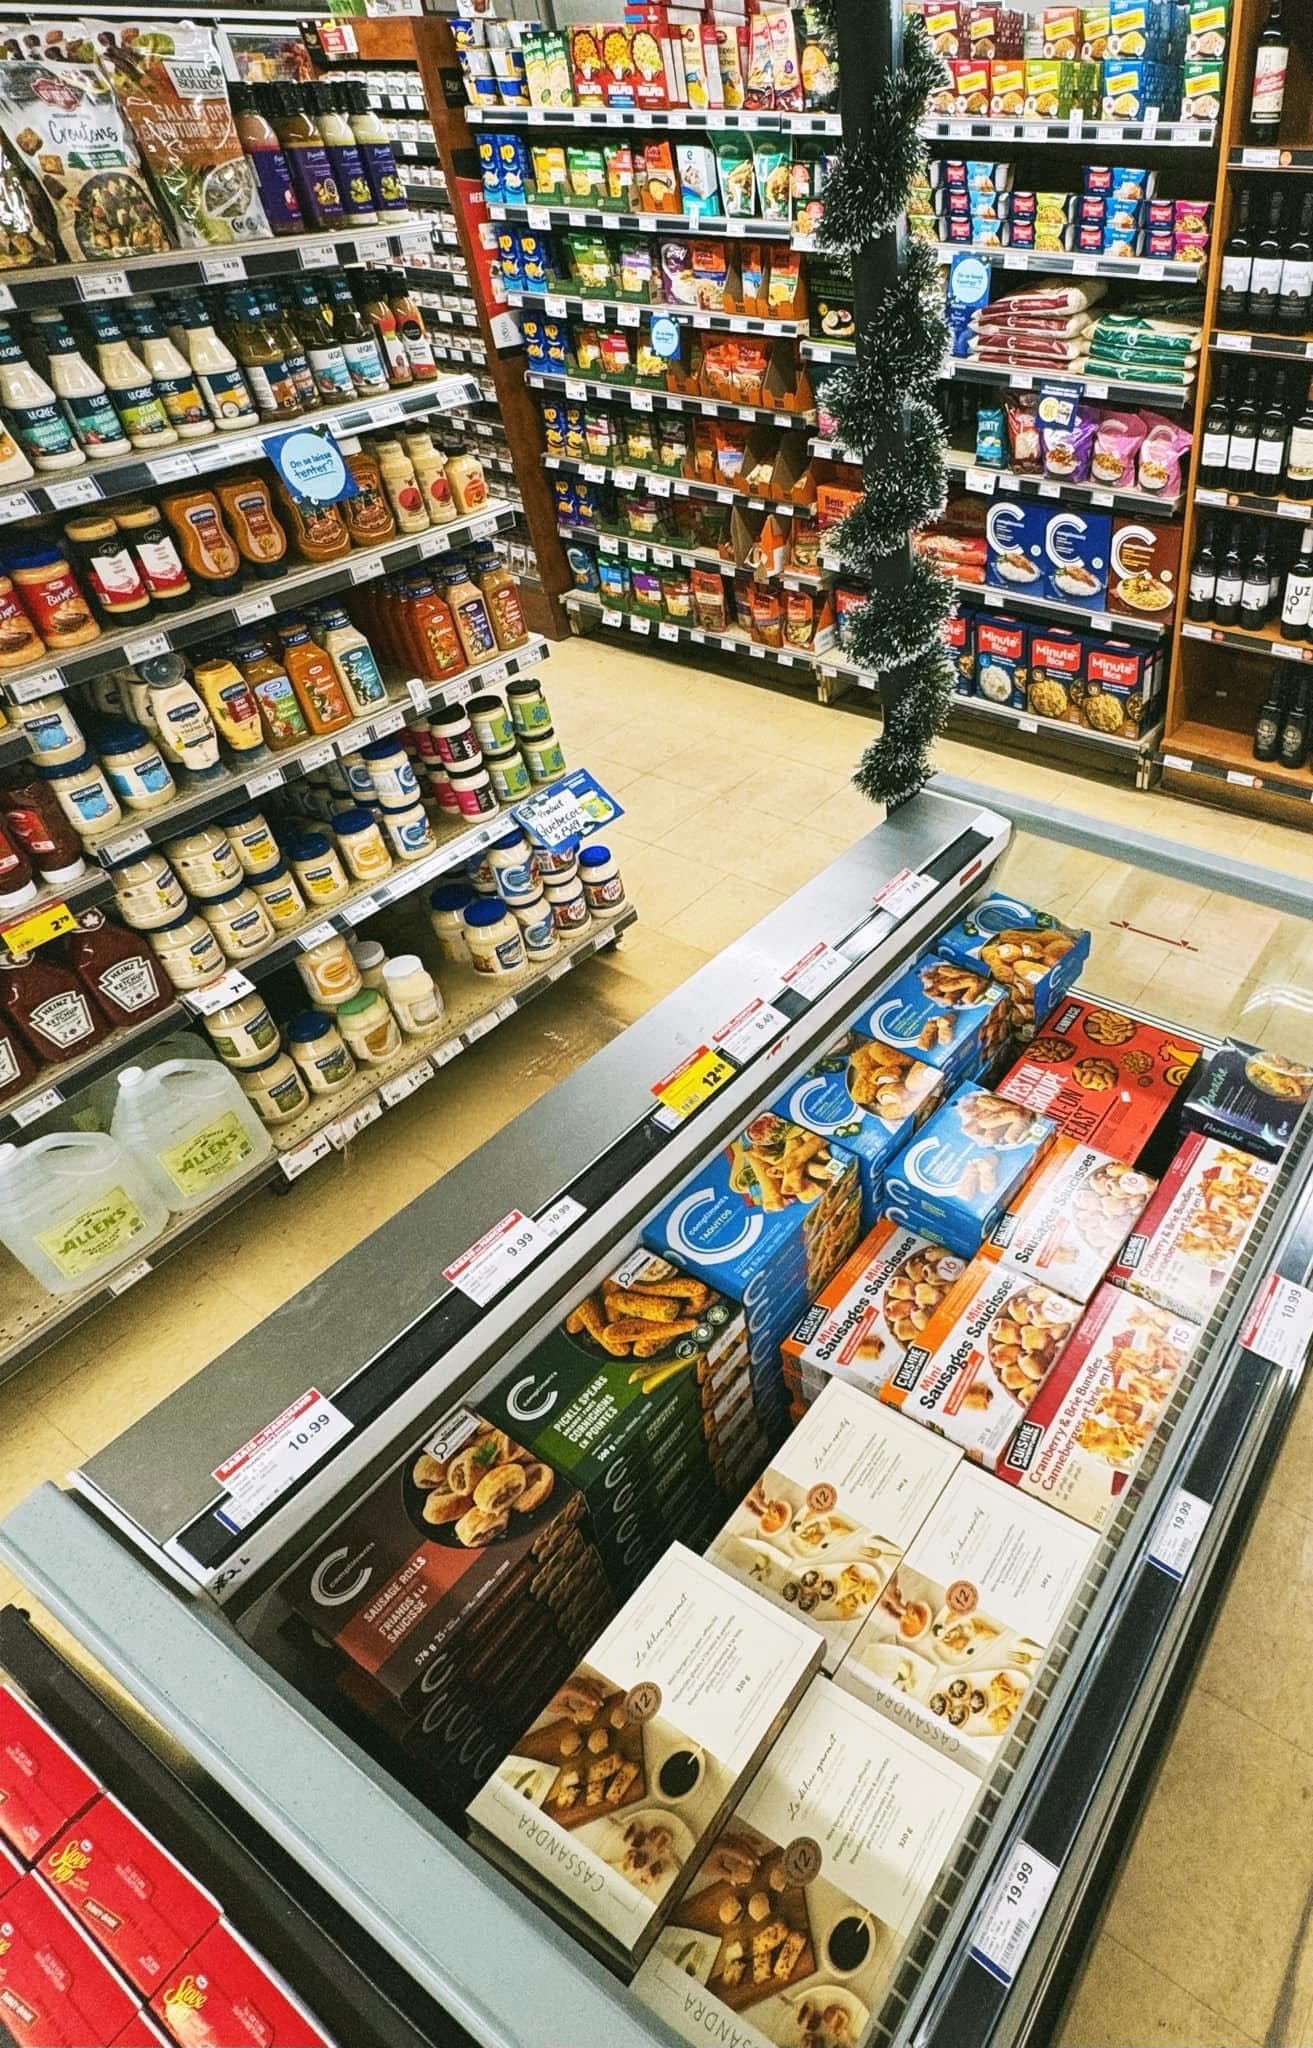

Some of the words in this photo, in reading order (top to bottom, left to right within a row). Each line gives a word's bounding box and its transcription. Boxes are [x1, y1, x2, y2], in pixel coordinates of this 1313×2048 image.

[48, 119, 118, 145] Croutons
[289, 458, 303, 470] On
[311, 452, 333, 465] laisse
[980, 631, 1018, 648] Minute
[1035, 644, 1078, 662] Minute
[1091, 657, 1135, 675] Minute
[109, 962, 135, 980] HEINZ
[113, 971, 146, 992] KETCHUP
[42, 997, 69, 1016] HEINZ
[45, 1005, 79, 1028] KETCHUP
[180, 1131, 238, 1173] ALLEN'S
[1057, 1152, 1097, 1206] Saucisses
[548, 1203, 571, 1225] 10.99
[689, 1194, 729, 1236] compliments
[699, 1208, 733, 1242] TAQUITOS
[61, 1207, 128, 1254] ALLEN'S
[506, 1232, 534, 1257] 9.99
[865, 1259, 885, 1281] Mini
[939, 1261, 957, 1274] 16
[815, 1296, 870, 1361] Sausages
[864, 1235, 917, 1295] Saucisses
[965, 1300, 986, 1323] Mini
[1282, 1289, 1302, 1319] 10.99
[817, 1320, 840, 1345] Mini
[919, 1338, 974, 1409] Sausages
[965, 1273, 1018, 1338] Saucisses
[1172, 1328, 1189, 1344] 15
[895, 1346, 924, 1387] CUISINE
[919, 1365, 942, 1392] Mini
[553, 1402, 582, 1433] PICKLE
[578, 1375, 609, 1406] SPEARS
[568, 1394, 615, 1443] CORNICHONS
[288, 1413, 331, 1452] 10.99
[585, 1406, 619, 1440] POINTES
[1029, 1427, 1067, 1484] Cranberry
[1064, 1394, 1080, 1418] Brie
[1077, 1357, 1104, 1397] Bundles
[1009, 1424, 1035, 1466] CUISINE
[1041, 1419, 1086, 1491] Canneberges
[815, 1490, 829, 1507] 12
[1173, 1501, 1192, 1530] 19.99
[363, 1581, 402, 1623] SAUSAGE
[399, 1555, 428, 1586] ROLLS
[955, 1588, 971, 1608] 12
[378, 1593, 415, 1638] FRIANDS
[385, 1599, 429, 1645] SAUCISSE
[634, 1693, 651, 1715] 12
[877, 1690, 961, 1753] CASSANDRA
[48, 1839, 92, 1872] Stove
[517, 1811, 606, 1894] CASSANDRA
[792, 1851, 811, 1874] 12
[1006, 1861, 1033, 1906] 19.99
[163, 1974, 209, 2009] Stove
